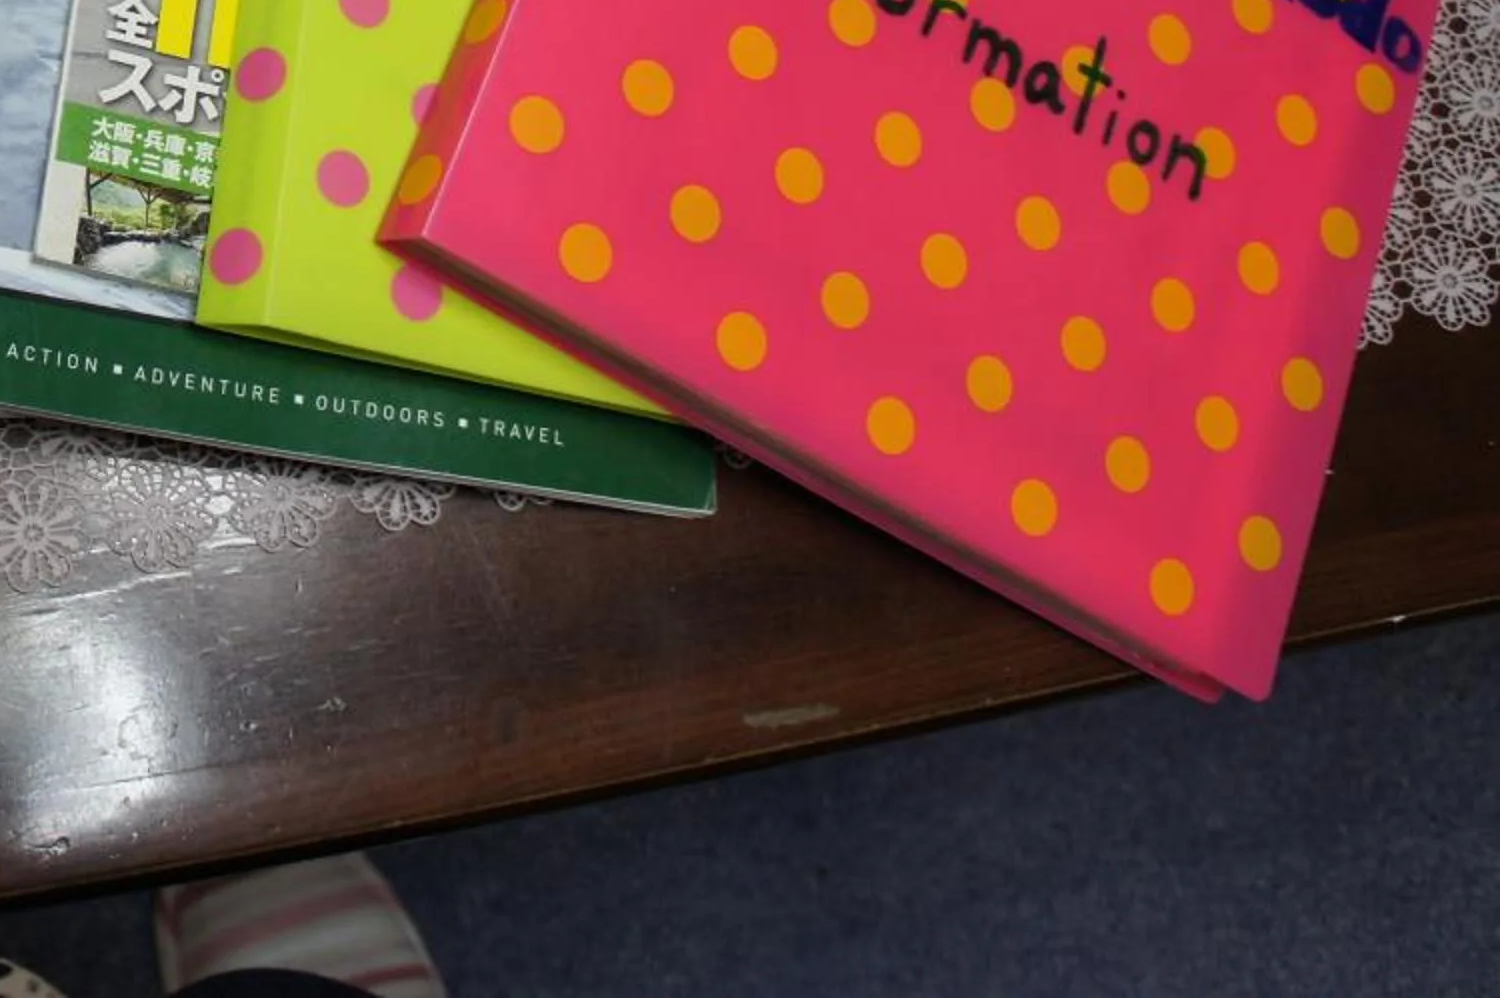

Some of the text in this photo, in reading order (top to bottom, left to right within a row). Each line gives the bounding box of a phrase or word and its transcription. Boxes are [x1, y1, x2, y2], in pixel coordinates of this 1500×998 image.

[99, 47, 227, 126] スポ
[91, 116, 216, 163] 大阪・兵庫・京
[6, 342, 566, 447] ACTION ADVENTURE OUTDOORS TRAVEL
